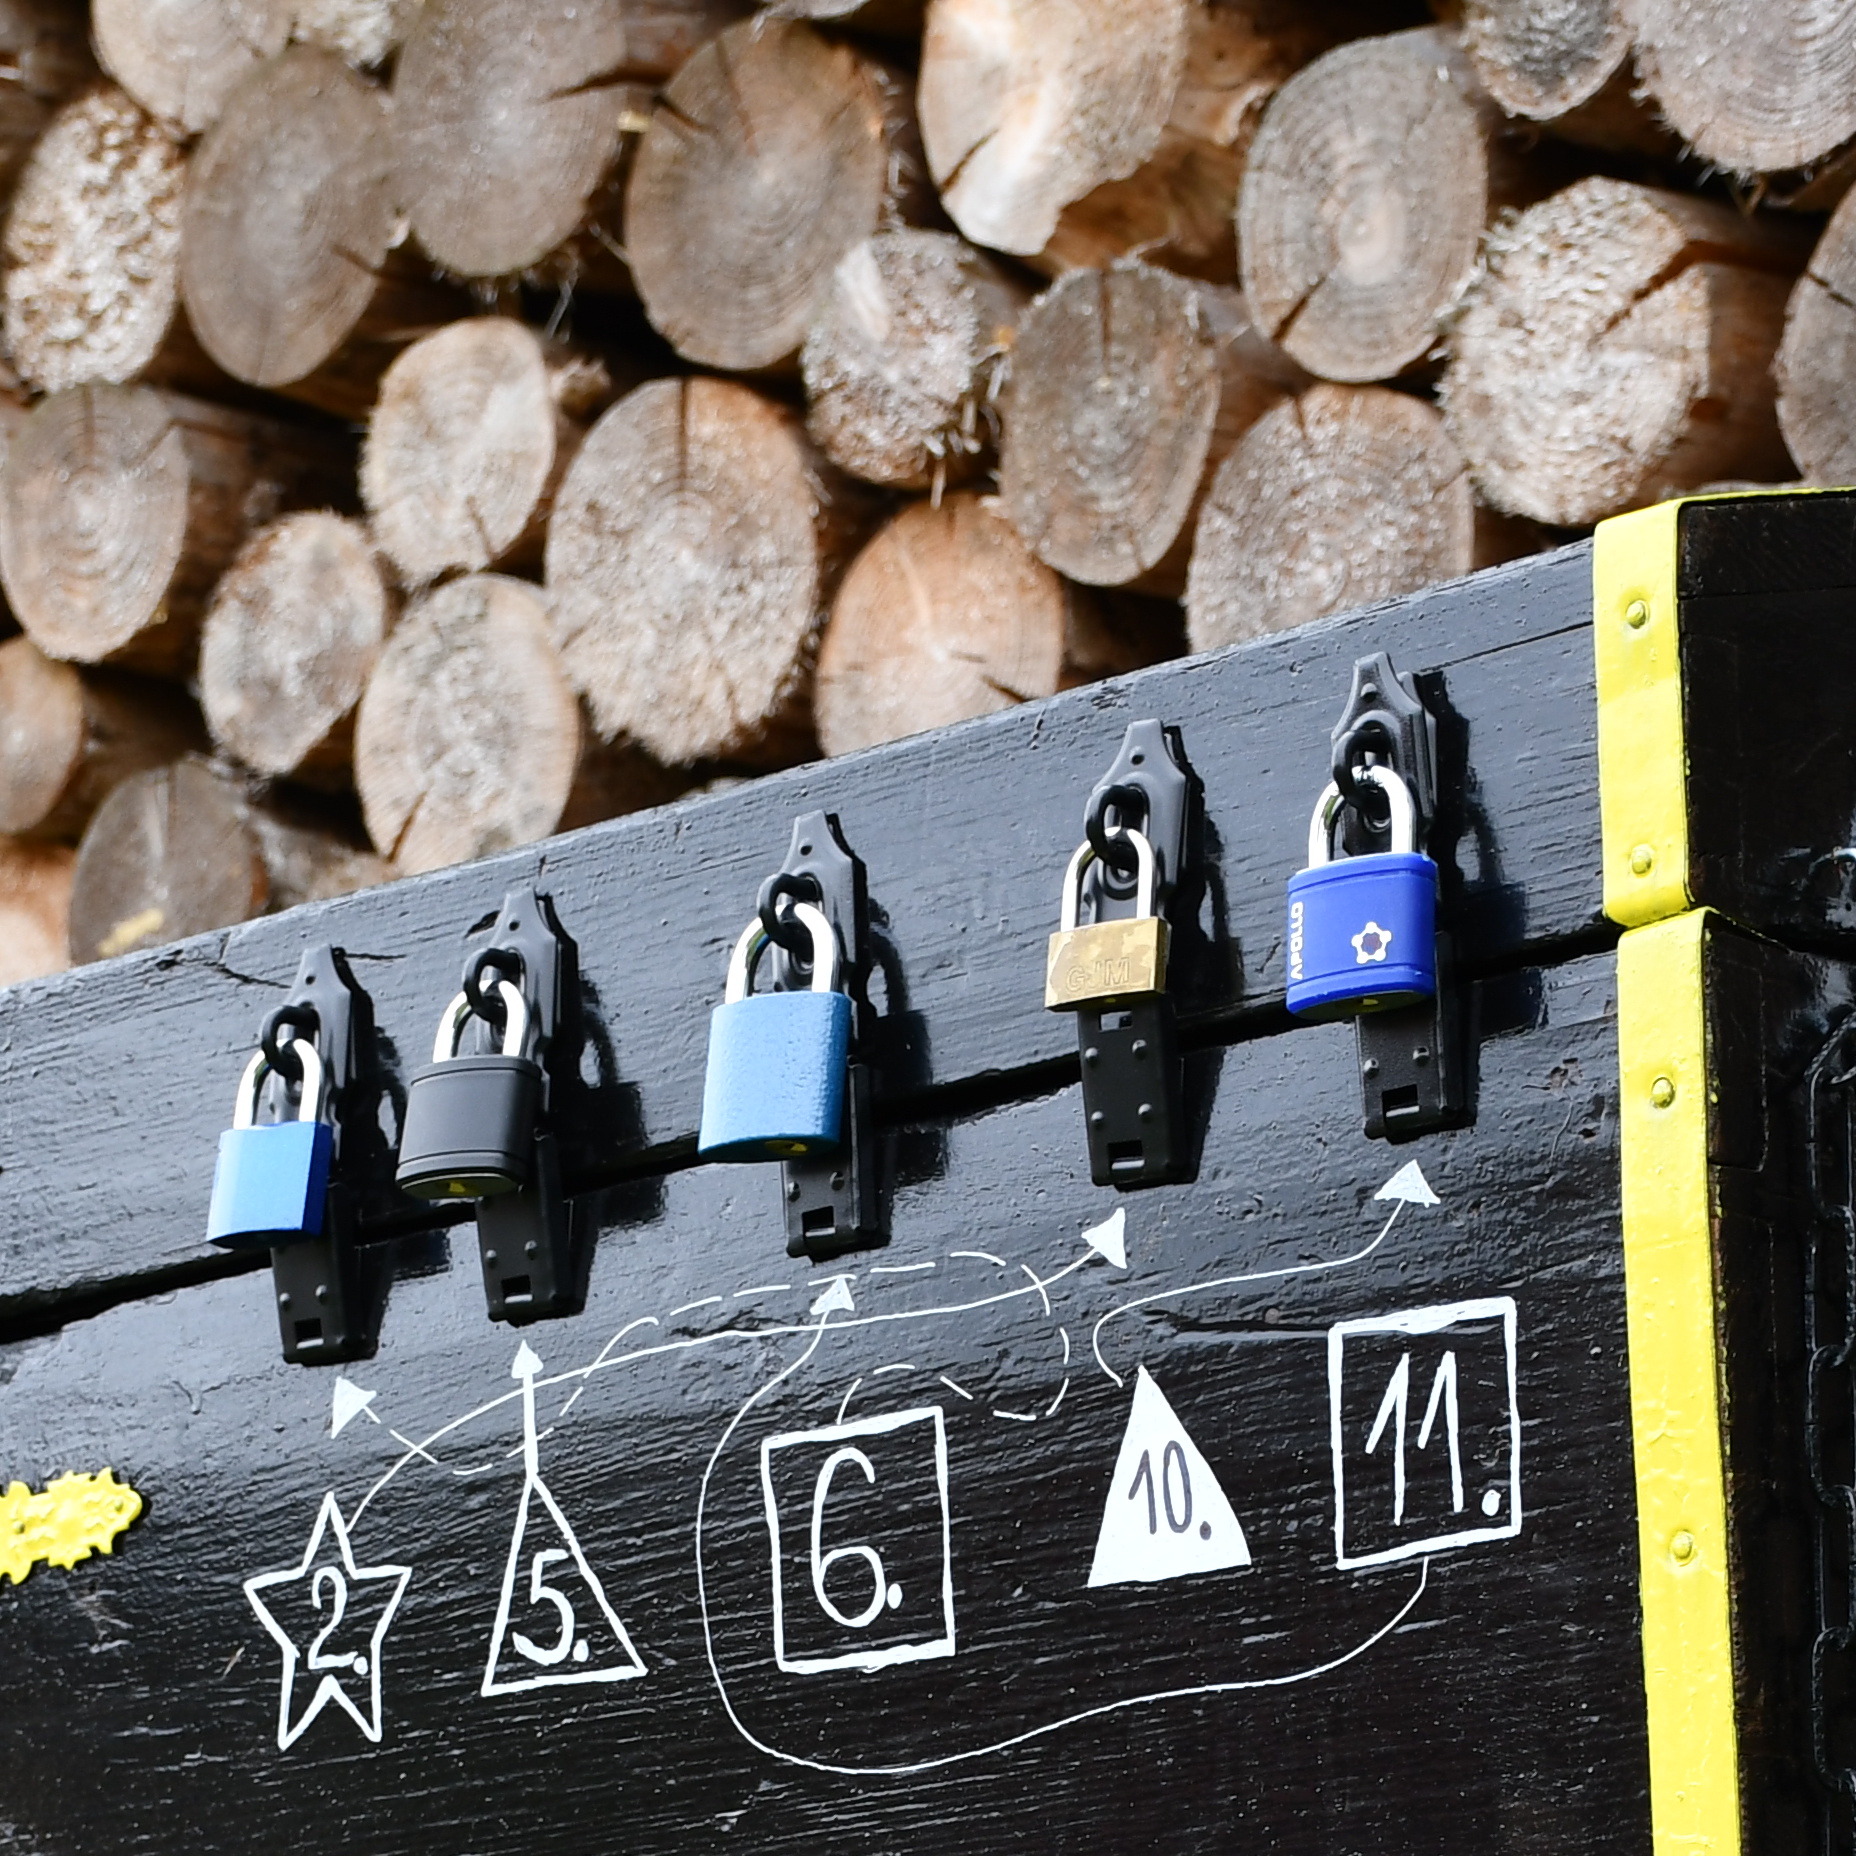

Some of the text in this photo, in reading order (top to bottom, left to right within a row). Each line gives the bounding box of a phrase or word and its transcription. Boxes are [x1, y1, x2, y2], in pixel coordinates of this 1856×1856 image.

[1290, 901, 1304, 980] APOLLO
[1127, 1440, 1212, 1541] 10.
[1364, 1350, 1502, 1527] 11.
[810, 1447, 903, 1628] 6.
[307, 1566, 369, 1676] 2.
[512, 1548, 590, 1667] 5.
